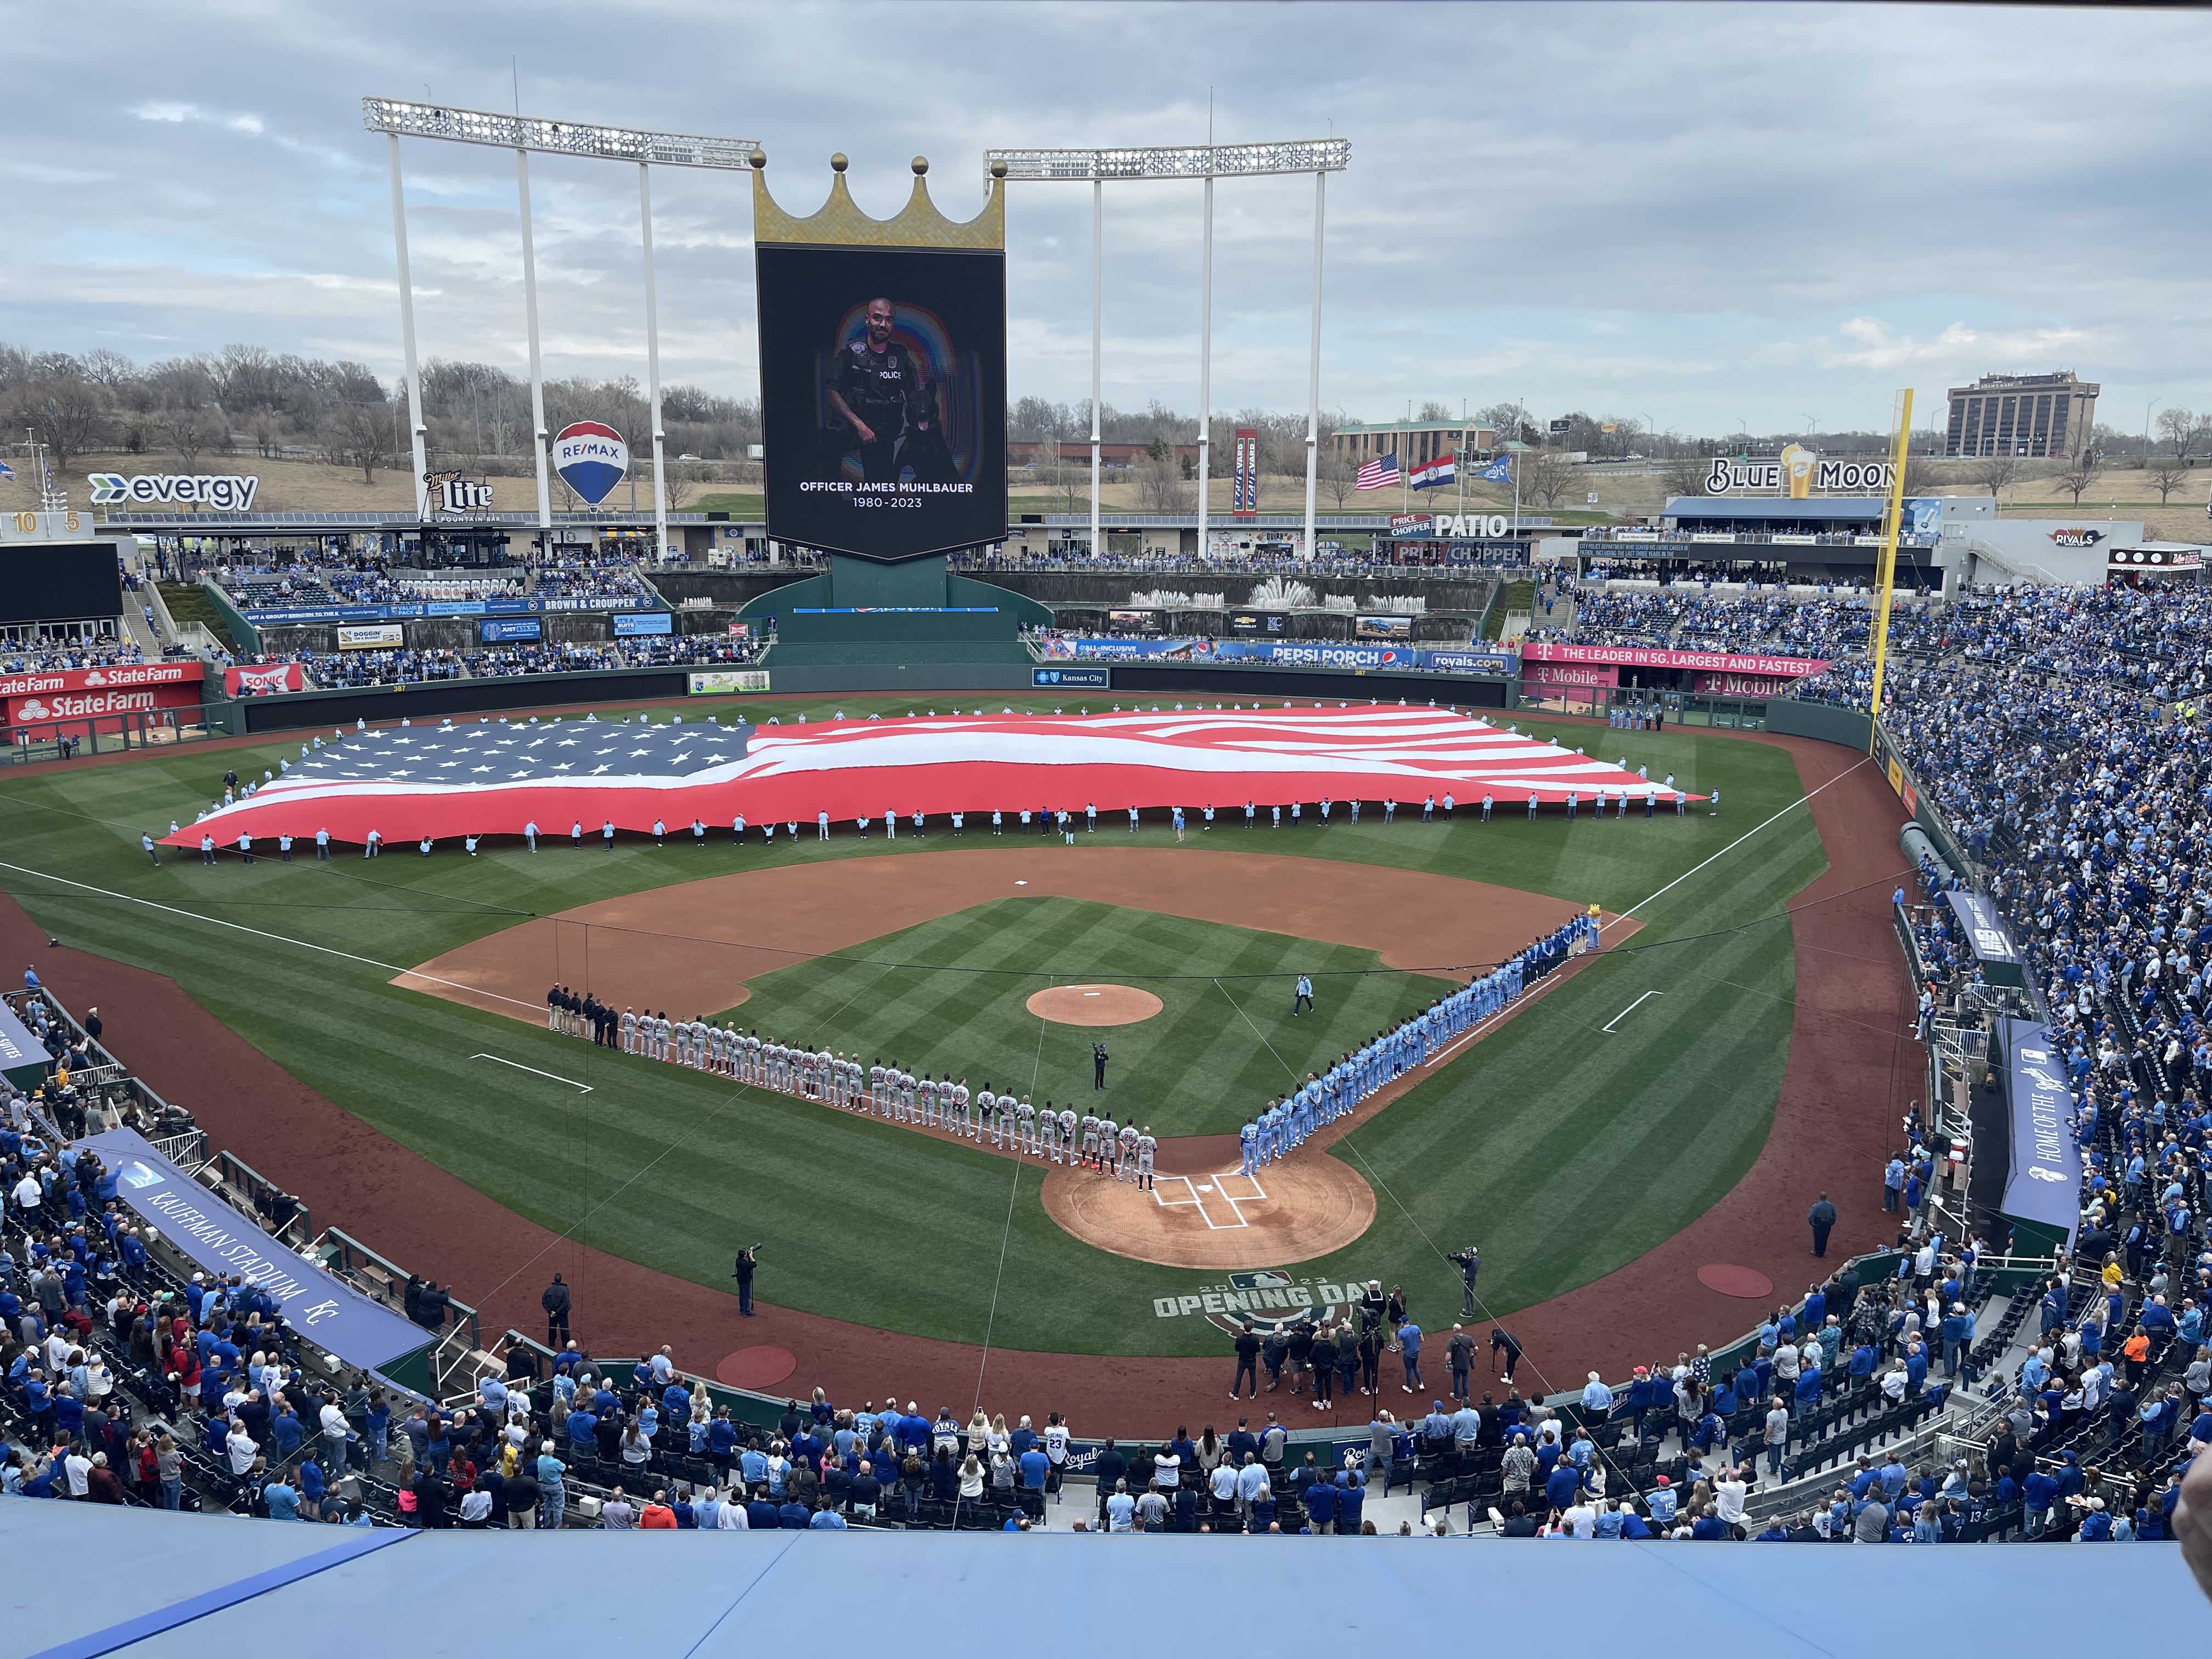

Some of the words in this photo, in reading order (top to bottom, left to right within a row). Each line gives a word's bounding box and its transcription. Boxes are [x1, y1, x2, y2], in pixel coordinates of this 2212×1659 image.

[879, 371, 901, 379] POLICE
[563, 444, 619, 459] RE/MAX
[424, 470, 461, 489] Miller
[1705, 458, 1781, 495] BLUE
[1818, 461, 1898, 488] MOON
[133, 479, 255, 507] evergy
[800, 482, 853, 492] OFFICER
[856, 482, 895, 492] JAMES
[899, 483, 973, 493] MUHLBAUER
[441, 481, 493, 514] Lite
[12, 513, 37, 533] 10
[65, 511, 81, 532] 5
[1392, 515, 1417, 526] PRICE
[1435, 515, 1508, 538] PATIO
[1391, 522, 1430, 536] CHOPPER
[2056, 535, 2093, 544] RIVALS
[545, 600, 578, 610] BROWN
[579, 599, 588, 609] &
[590, 598, 637, 608] CROUPPEN
[1085, 645, 1137, 653] ALL-INCLUSIVE
[1273, 647, 1318, 662] PEPSI
[1322, 650, 1379, 664] PORCH
[1562, 648, 1584, 659] THE
[1588, 650, 1632, 662] LEADER
[1636, 652, 1647, 663] IN
[1650, 653, 1669, 664] 5G.
[1672, 654, 1727, 668] LARGEST
[1729, 658, 1756, 670] AND
[1759, 660, 1812, 674] FASTEST
[1435, 656, 1503, 669] royals.com
[246, 675, 283, 687] SONIC
[1088, 674, 1103, 683] City
[1552, 668, 1598, 685] Mobile
[2032, 1092, 2056, 1113] THE
[2033, 1112, 2057, 1128] OF
[1248, 1131, 1256, 1139] 33
[2034, 1128, 2062, 1163] HOME
[147, 1191, 238, 1249] KAUFFMAN
[219, 1244, 308, 1301] STADIUM
[1200, 1284, 1228, 1293] 20
[1153, 1287, 1313, 1317] OPENING
[304, 1299, 340, 1325] KC
[228, 1405, 237, 1415] 13
[509, 1401, 517, 1413] 19
[858, 1424, 872, 1435] 23
[1049, 1439, 1062, 1449] 23
[1150, 1504, 1156, 1515] 11
[1664, 1502, 1674, 1514] 15
[1970, 1511, 1982, 1522] 13
[1822, 1522, 1829, 1531] 5
[1956, 1526, 1962, 1538] 7
